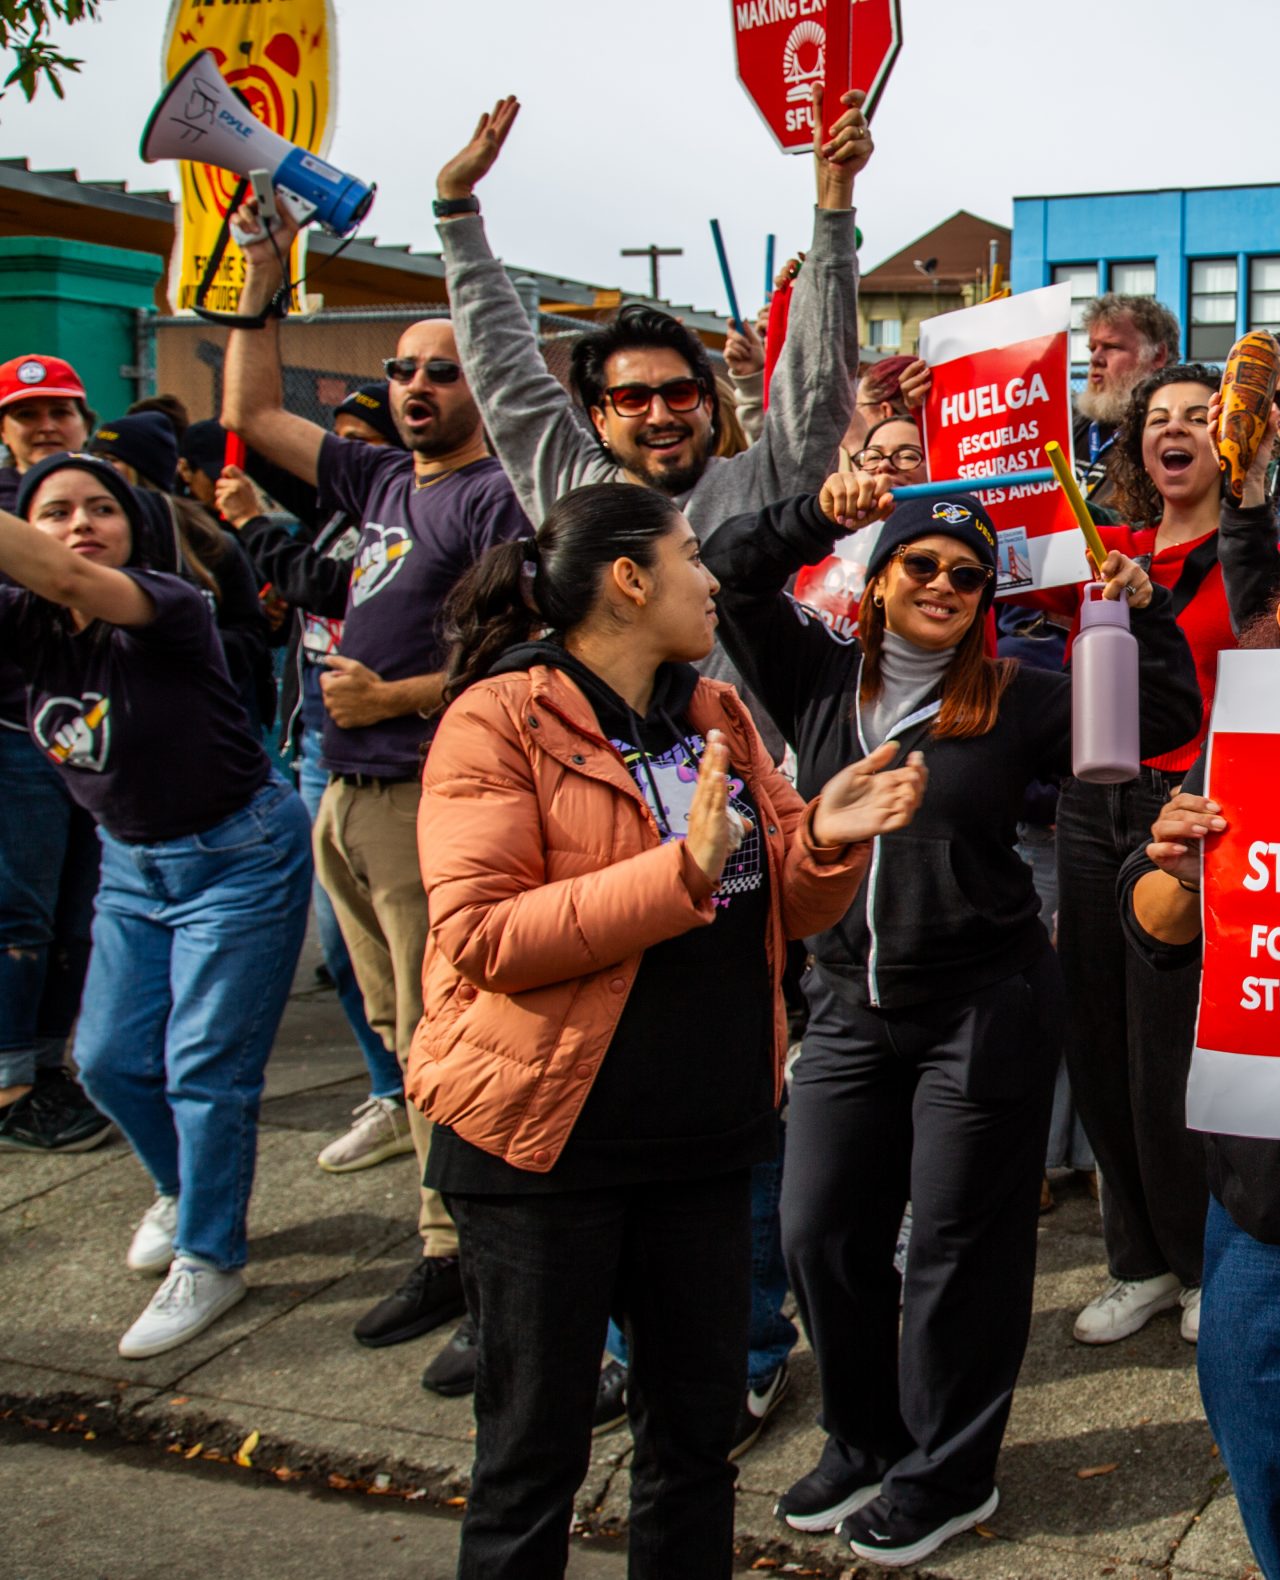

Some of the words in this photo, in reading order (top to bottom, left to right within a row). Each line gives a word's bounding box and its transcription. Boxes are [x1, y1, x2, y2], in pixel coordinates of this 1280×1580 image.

[736, 0, 797, 31] MAKING
[218, 110, 255, 138] PYLE
[941, 373, 1049, 427] HUELGA
[957, 451, 1028, 481] SEGURAS
[1028, 448, 1040, 466] Y
